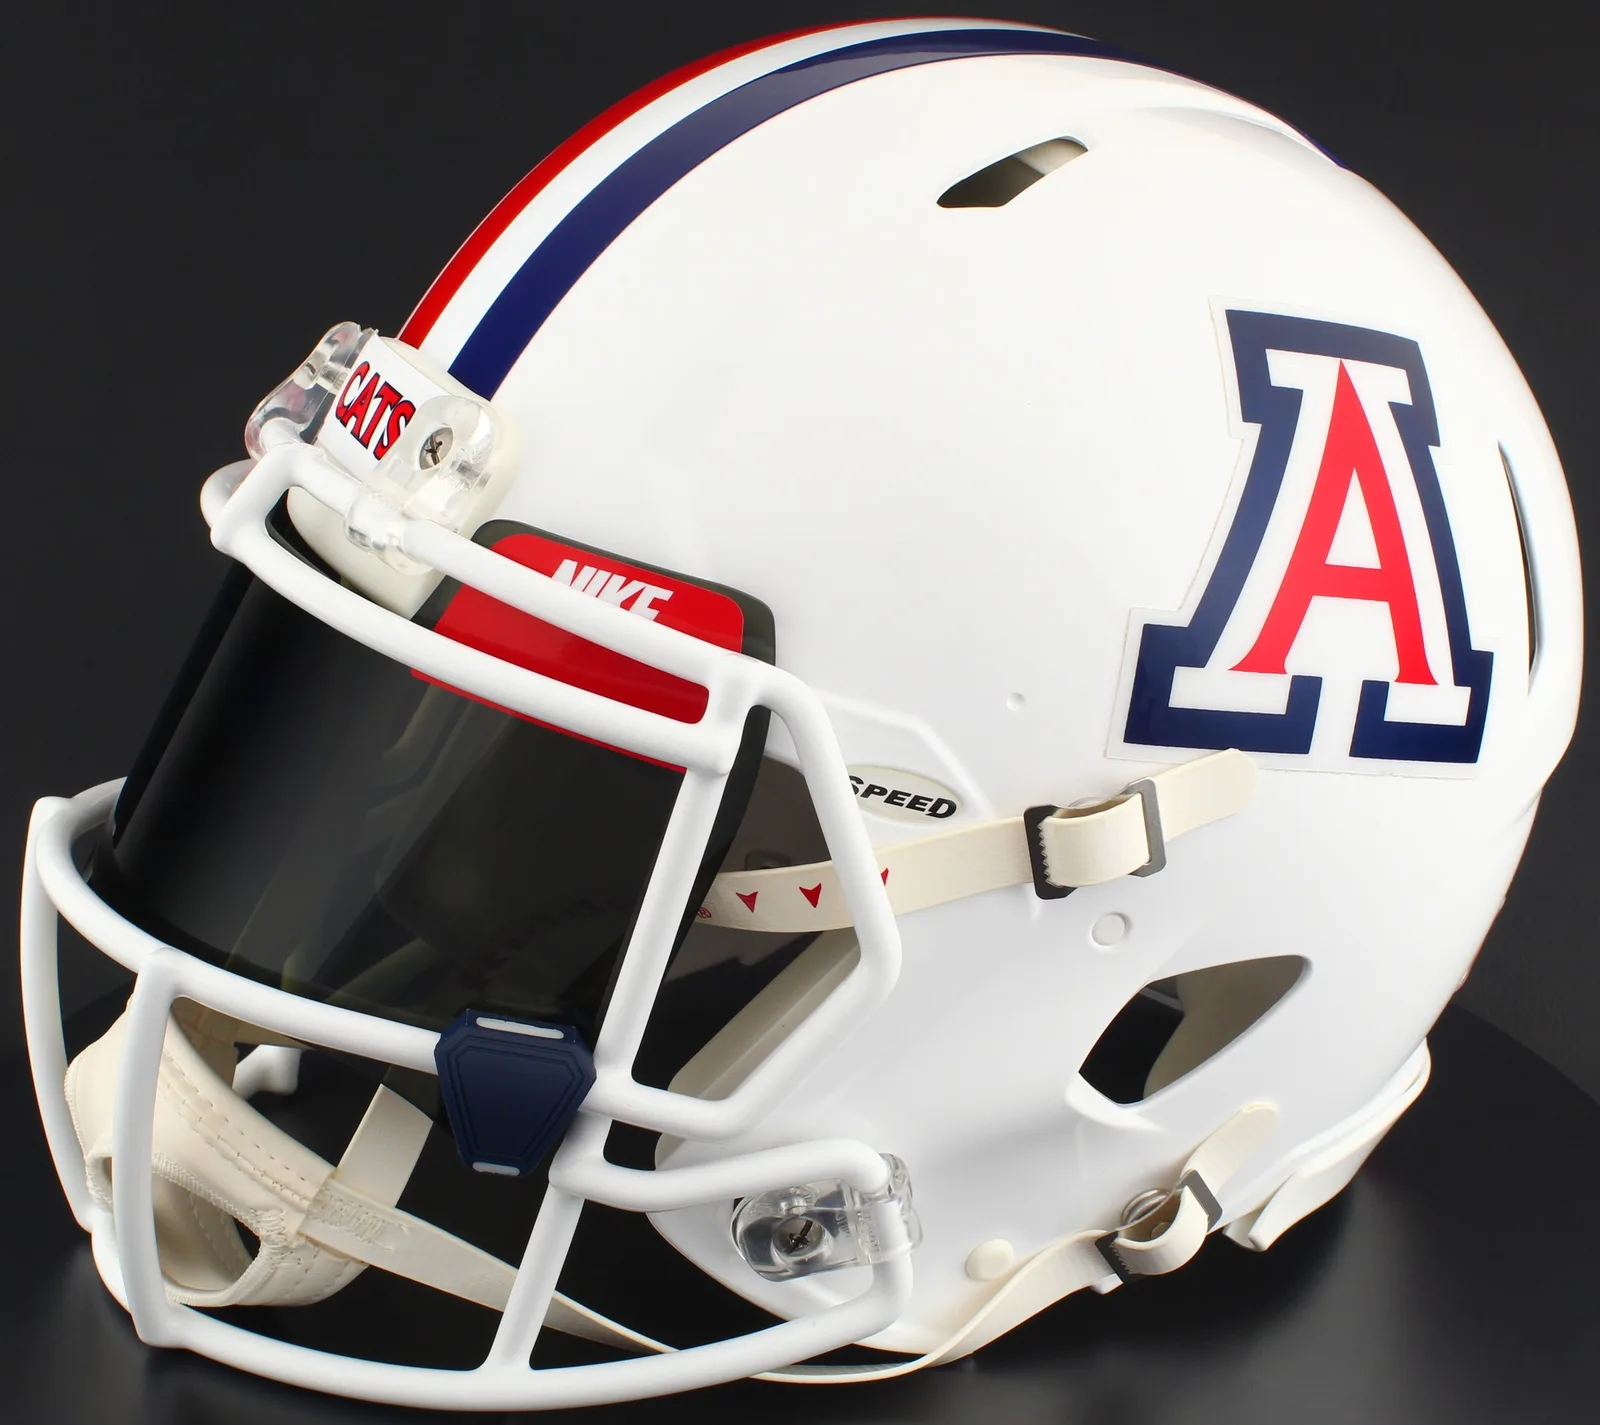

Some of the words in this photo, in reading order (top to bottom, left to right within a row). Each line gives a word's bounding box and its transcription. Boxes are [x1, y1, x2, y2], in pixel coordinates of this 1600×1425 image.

[335, 361, 416, 460] CATS
[1123, 309, 1494, 763] A
[849, 775, 957, 819] SPEED
